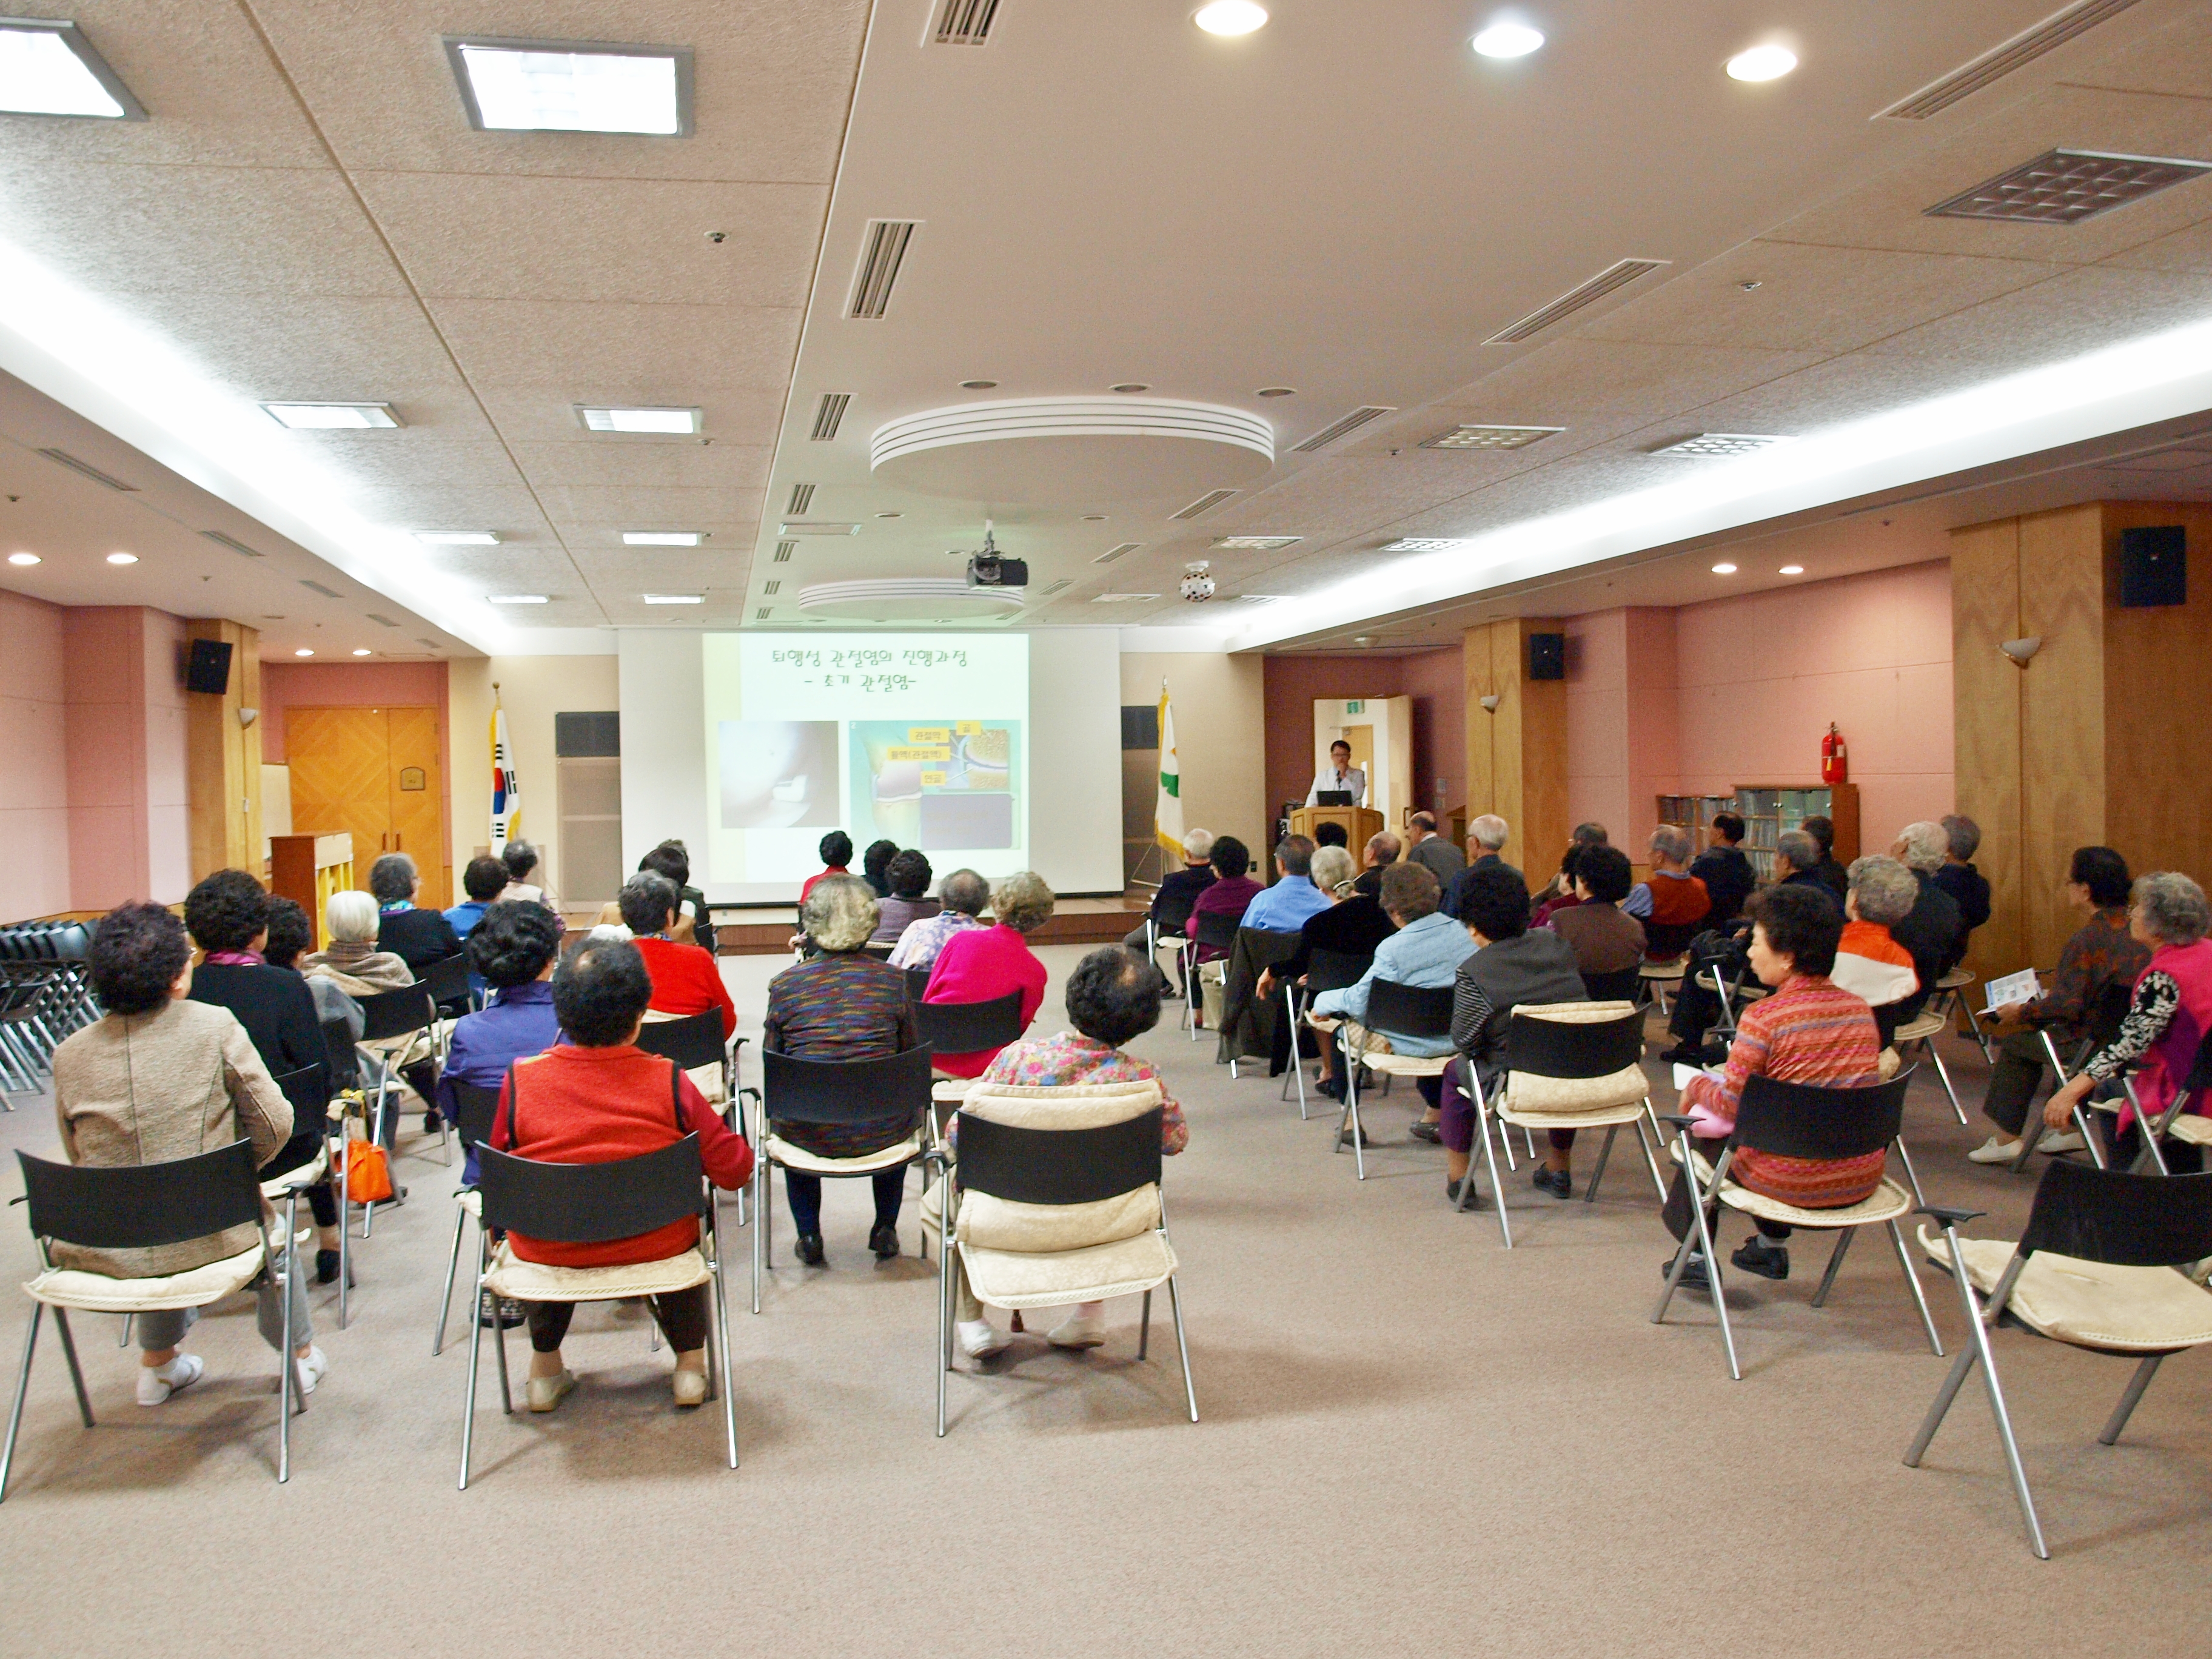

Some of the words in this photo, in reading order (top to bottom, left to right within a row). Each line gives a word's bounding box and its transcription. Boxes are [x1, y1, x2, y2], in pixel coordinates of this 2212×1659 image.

[773, 650, 820, 667] 퇴행성
[830, 650, 892, 668] 관절염의
[903, 650, 967, 667] 진행과정
[825, 674, 850, 686] 초기
